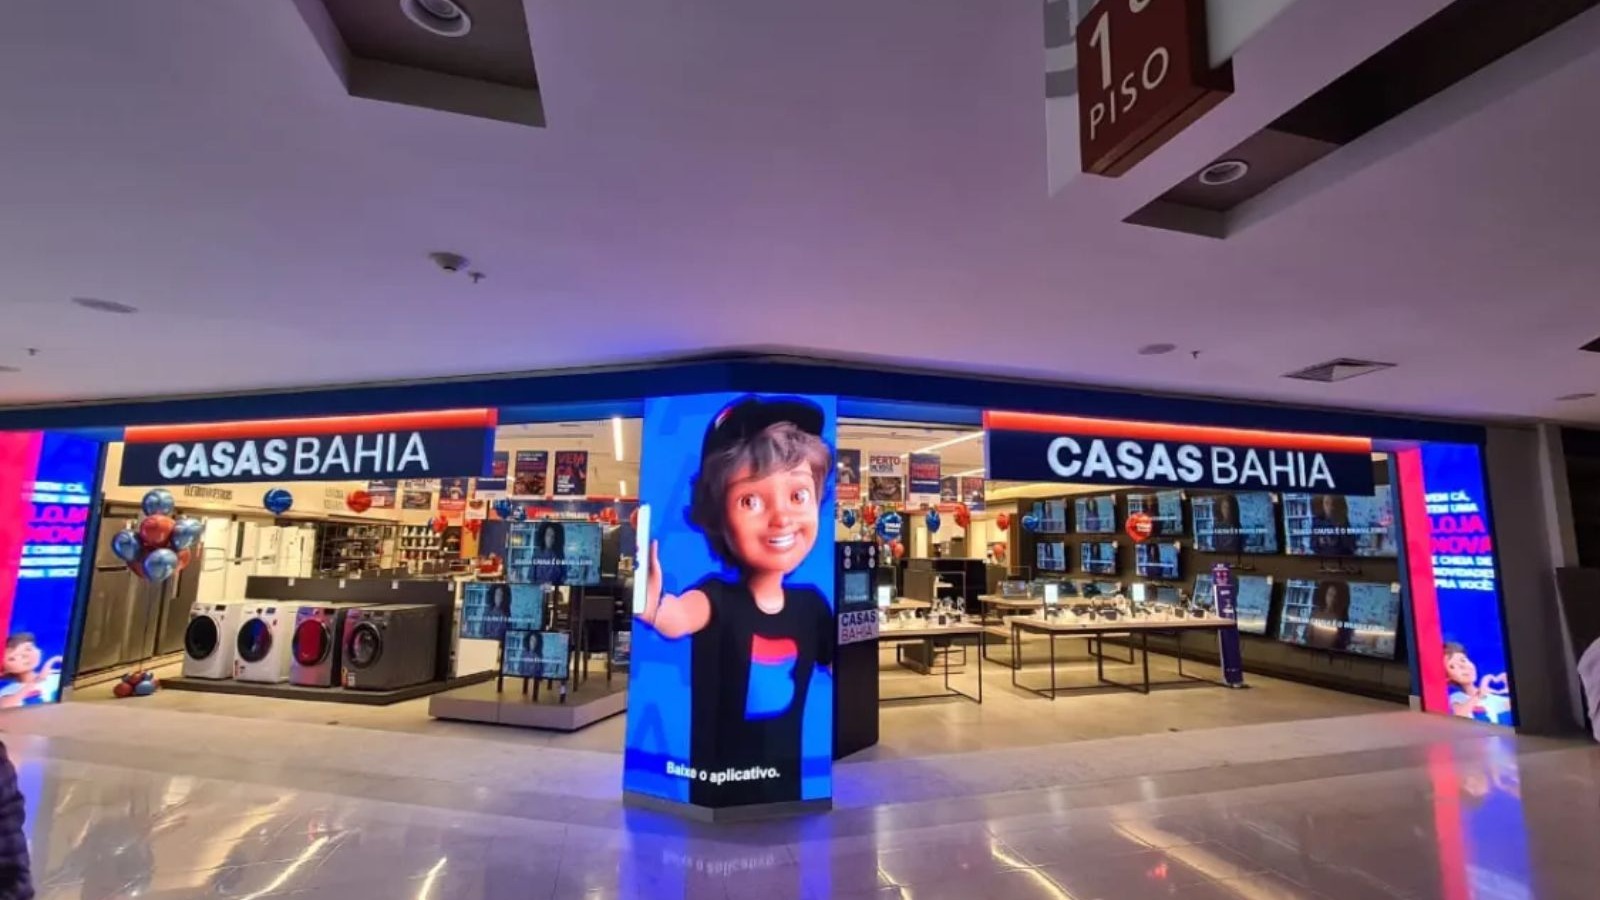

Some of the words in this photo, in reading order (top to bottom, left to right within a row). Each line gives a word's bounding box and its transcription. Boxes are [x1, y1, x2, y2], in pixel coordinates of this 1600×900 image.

[1089, 46, 1169, 141] PISO
[157, 439, 288, 479] CASAS
[293, 431, 430, 475] BAHIA
[870, 456, 901, 465] PERTO
[1047, 436, 1204, 482] CASAS
[1210, 446, 1336, 488] BAHIA
[1424, 515, 1486, 533] LOJA
[841, 611, 877, 627] CASAS
[841, 626, 873, 642] BAHIA
[666, 761, 697, 779] Baixe
[699, 770, 707, 781] o
[709, 765, 781, 785] aplicativo.
